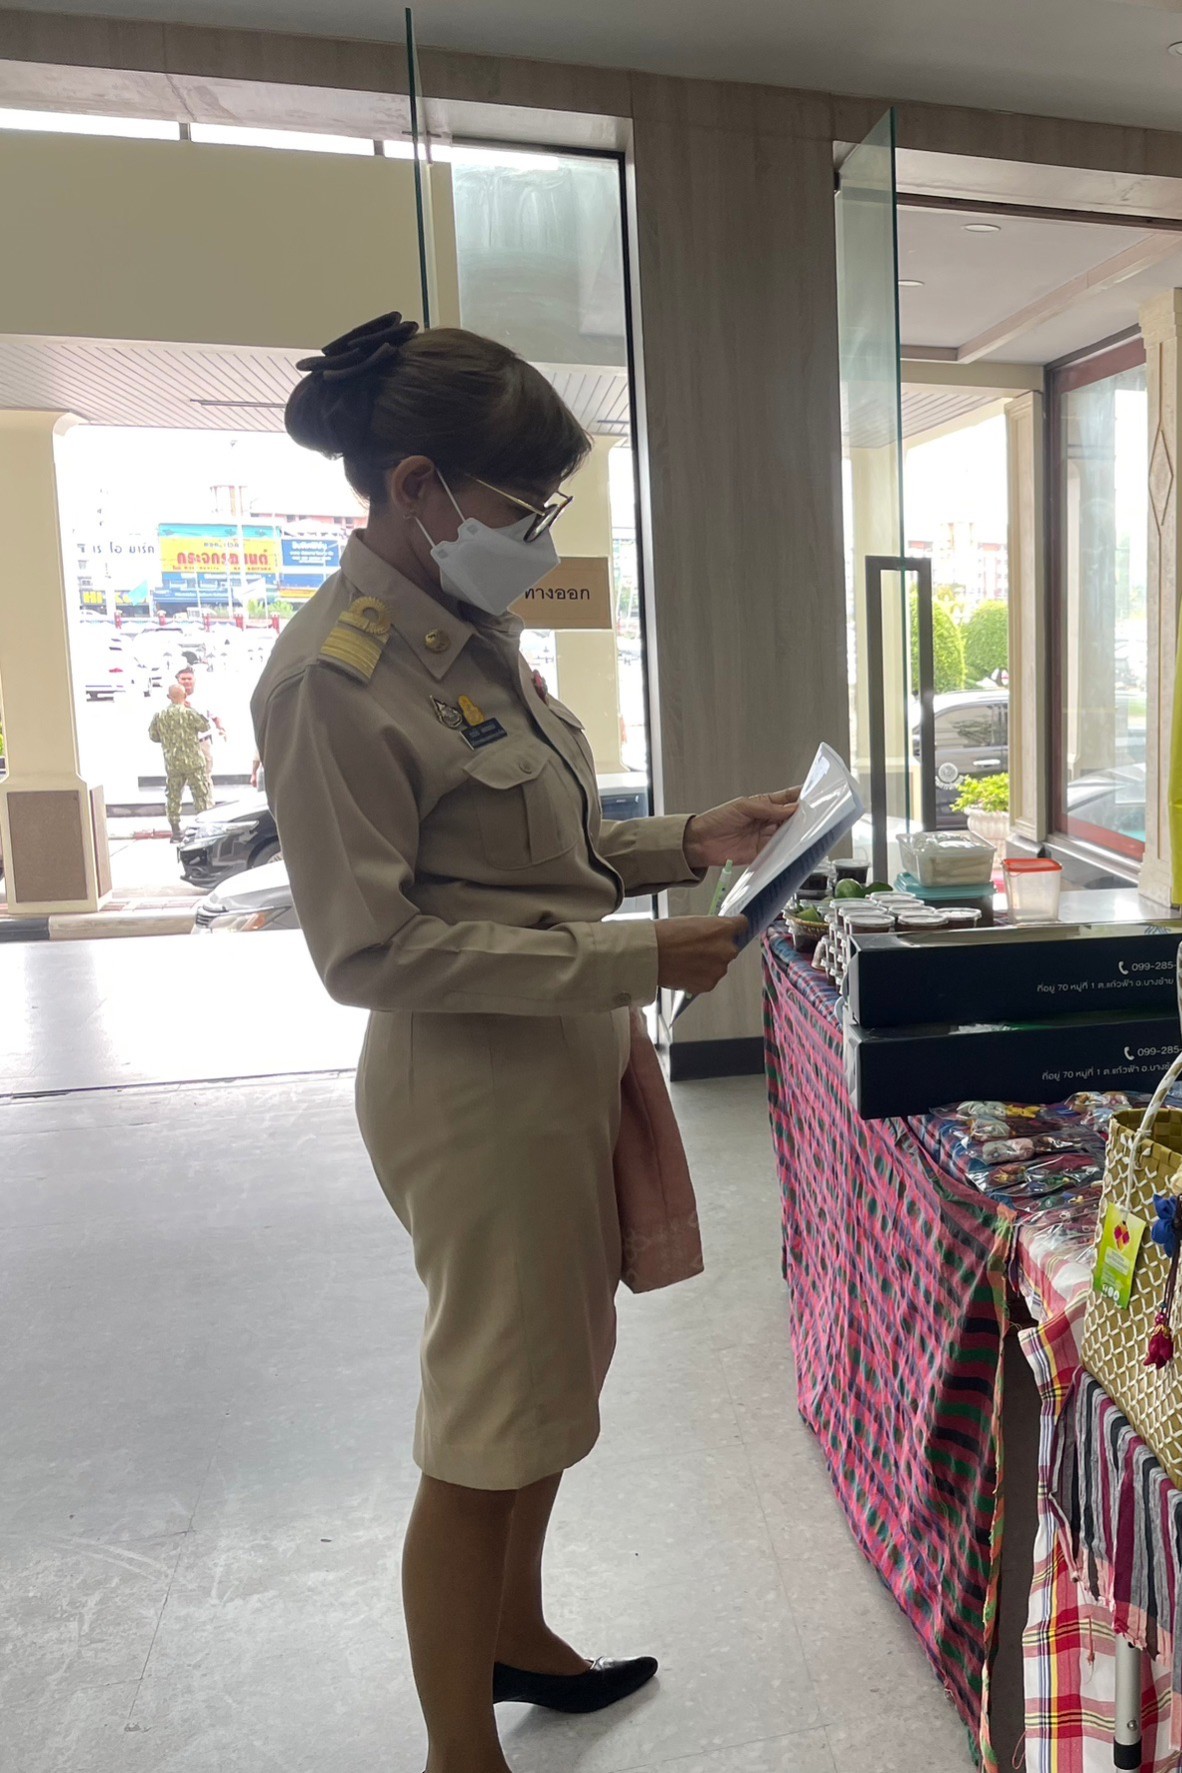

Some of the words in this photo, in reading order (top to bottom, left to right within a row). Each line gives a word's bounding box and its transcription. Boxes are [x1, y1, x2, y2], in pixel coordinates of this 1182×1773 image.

[525, 588, 590, 600] ทางออก
[1057, 983, 1069, 991] 70
[1063, 1071, 1074, 1079] 70
